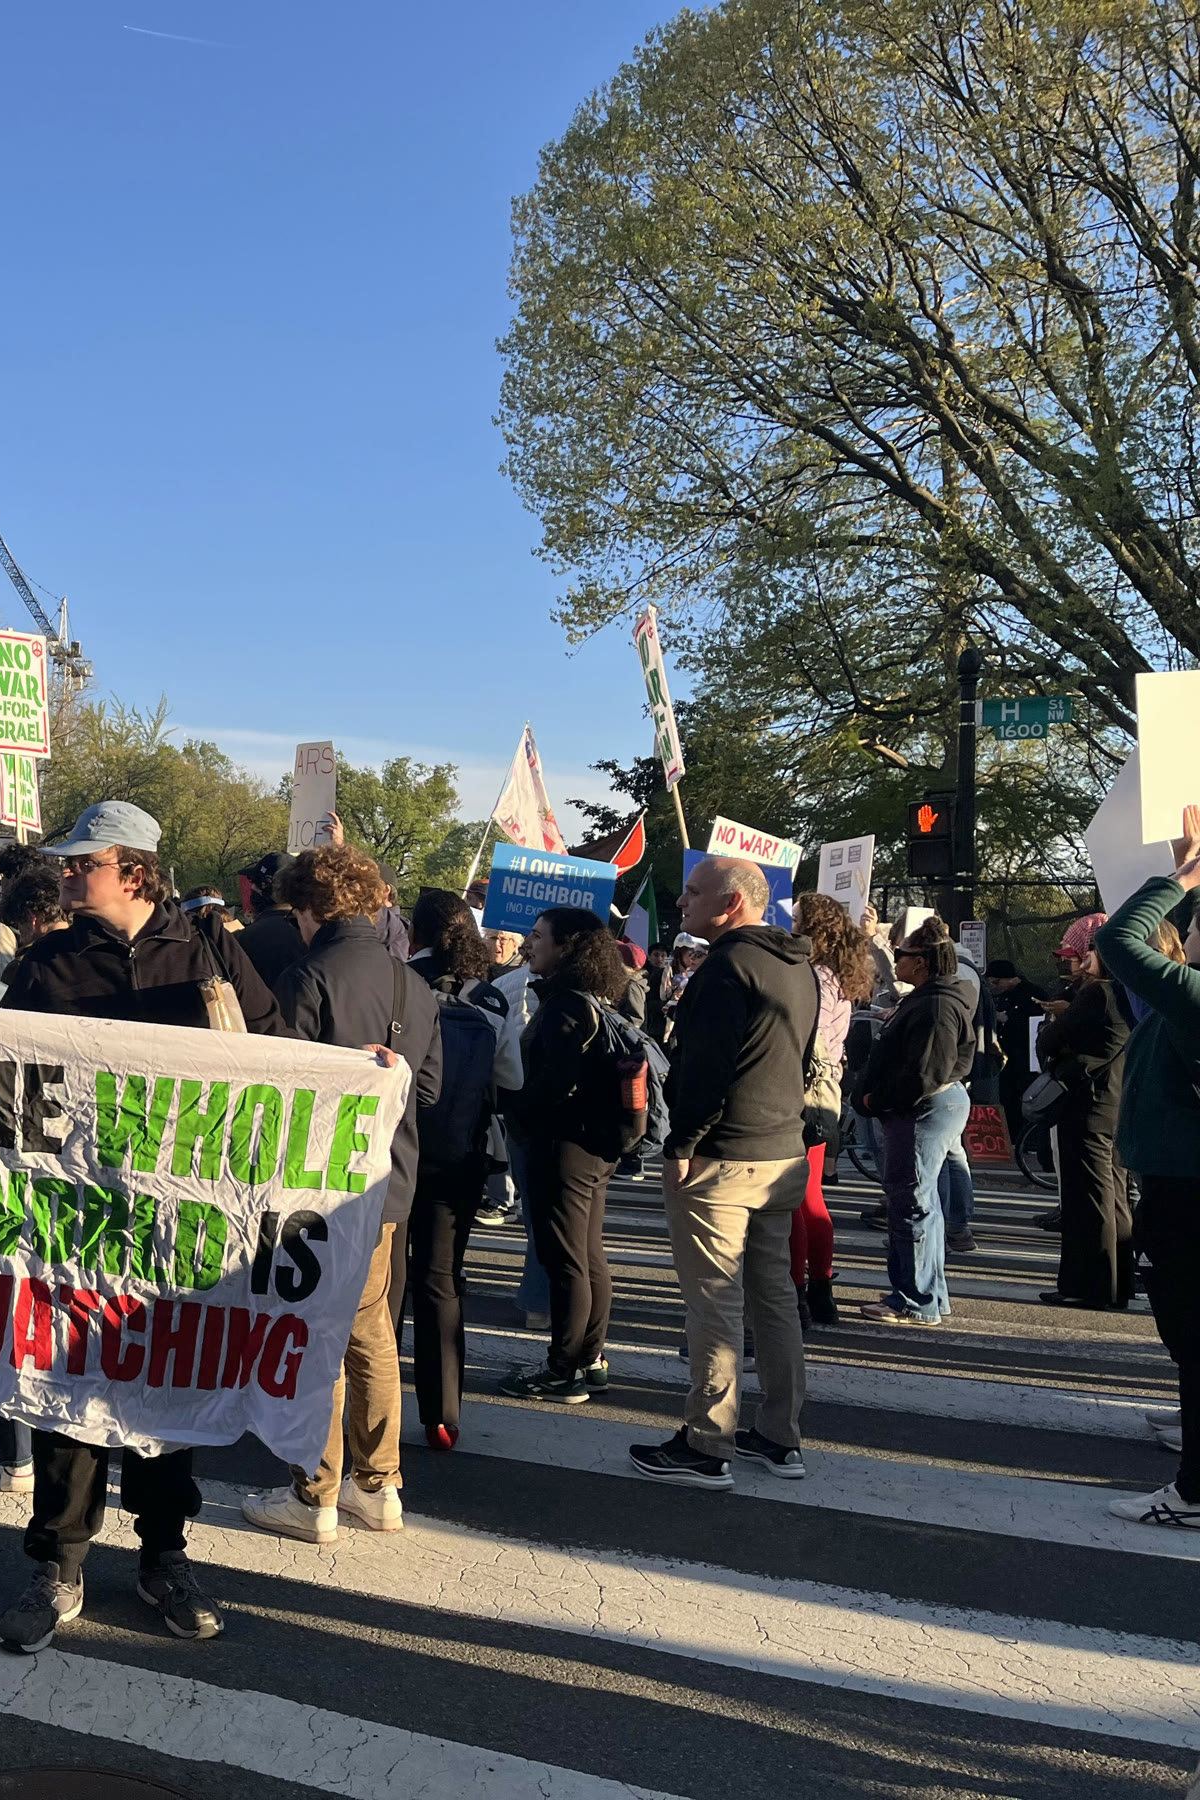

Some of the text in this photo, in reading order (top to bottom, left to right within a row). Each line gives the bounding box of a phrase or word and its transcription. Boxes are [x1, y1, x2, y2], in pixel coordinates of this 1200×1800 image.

[1002, 699, 1064, 721] H St
[1048, 710, 1065, 720] NW
[1000, 723, 1043, 738] 1600
[9, 792, 34, 819] IAN
[716, 825, 736, 844] NO
[739, 831, 779, 861] WAR!
[502, 876, 595, 910] NEIGHBOR
[95, 1071, 380, 1193] WHOLE
[968, 1133, 1008, 1153] GOD
[250, 1209, 328, 1302] IS
